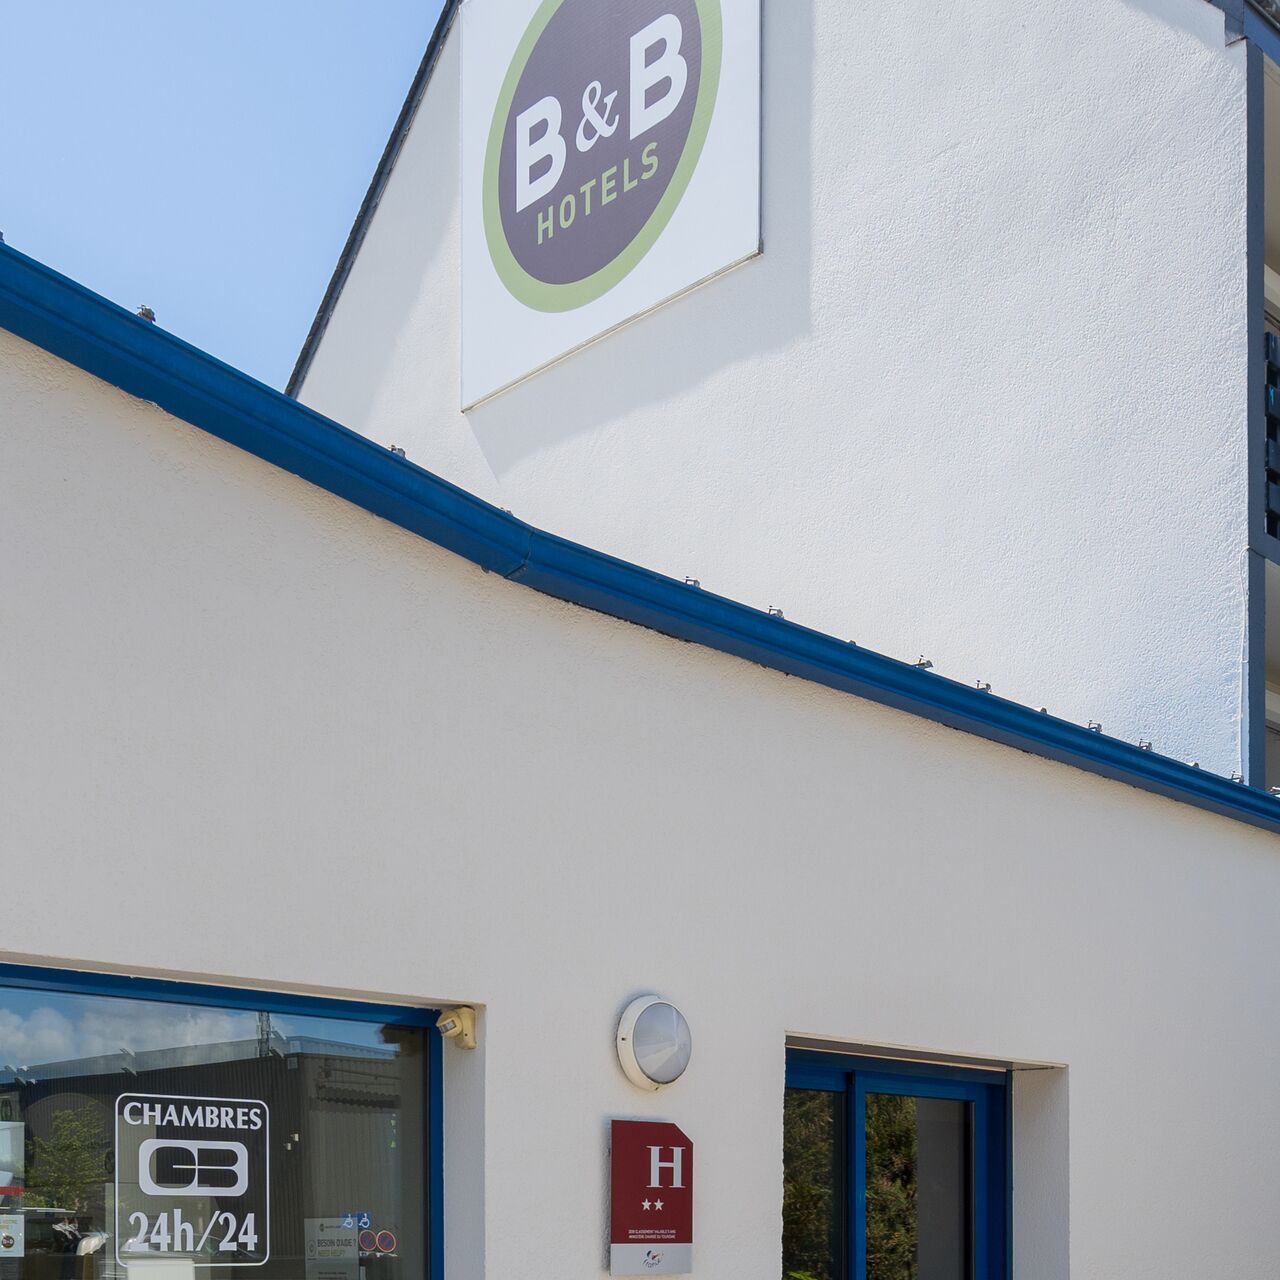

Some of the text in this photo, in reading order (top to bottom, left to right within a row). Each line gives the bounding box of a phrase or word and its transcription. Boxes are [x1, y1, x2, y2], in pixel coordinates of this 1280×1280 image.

[516, 13, 688, 214] B&B
[536, 141, 659, 246] HOTELS
[123, 1101, 263, 1130] CHAMBRES
[645, 1145, 687, 1189] H
[128, 1208, 259, 1252] 24h/24
